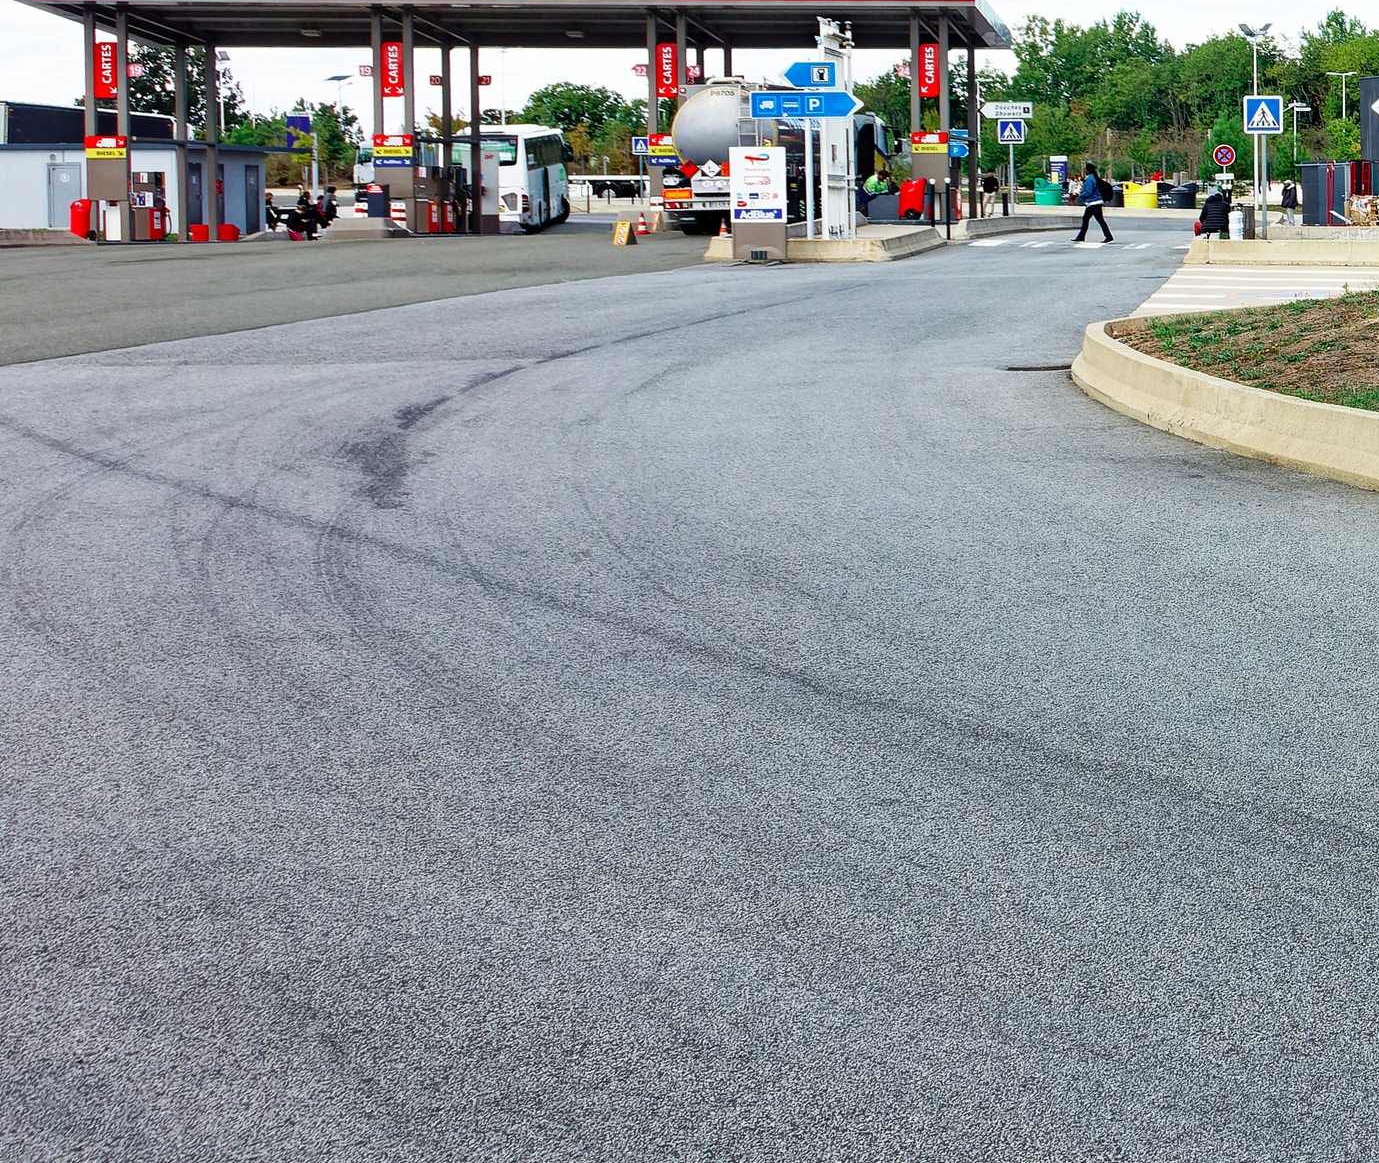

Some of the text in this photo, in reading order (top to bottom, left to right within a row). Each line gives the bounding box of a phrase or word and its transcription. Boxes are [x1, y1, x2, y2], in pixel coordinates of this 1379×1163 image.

[102, 44, 112, 84] CARTES
[388, 45, 399, 84] CARTES
[662, 46, 672, 85] CARTES
[925, 47, 935, 85] CARTES
[808, 98, 820, 111] P
